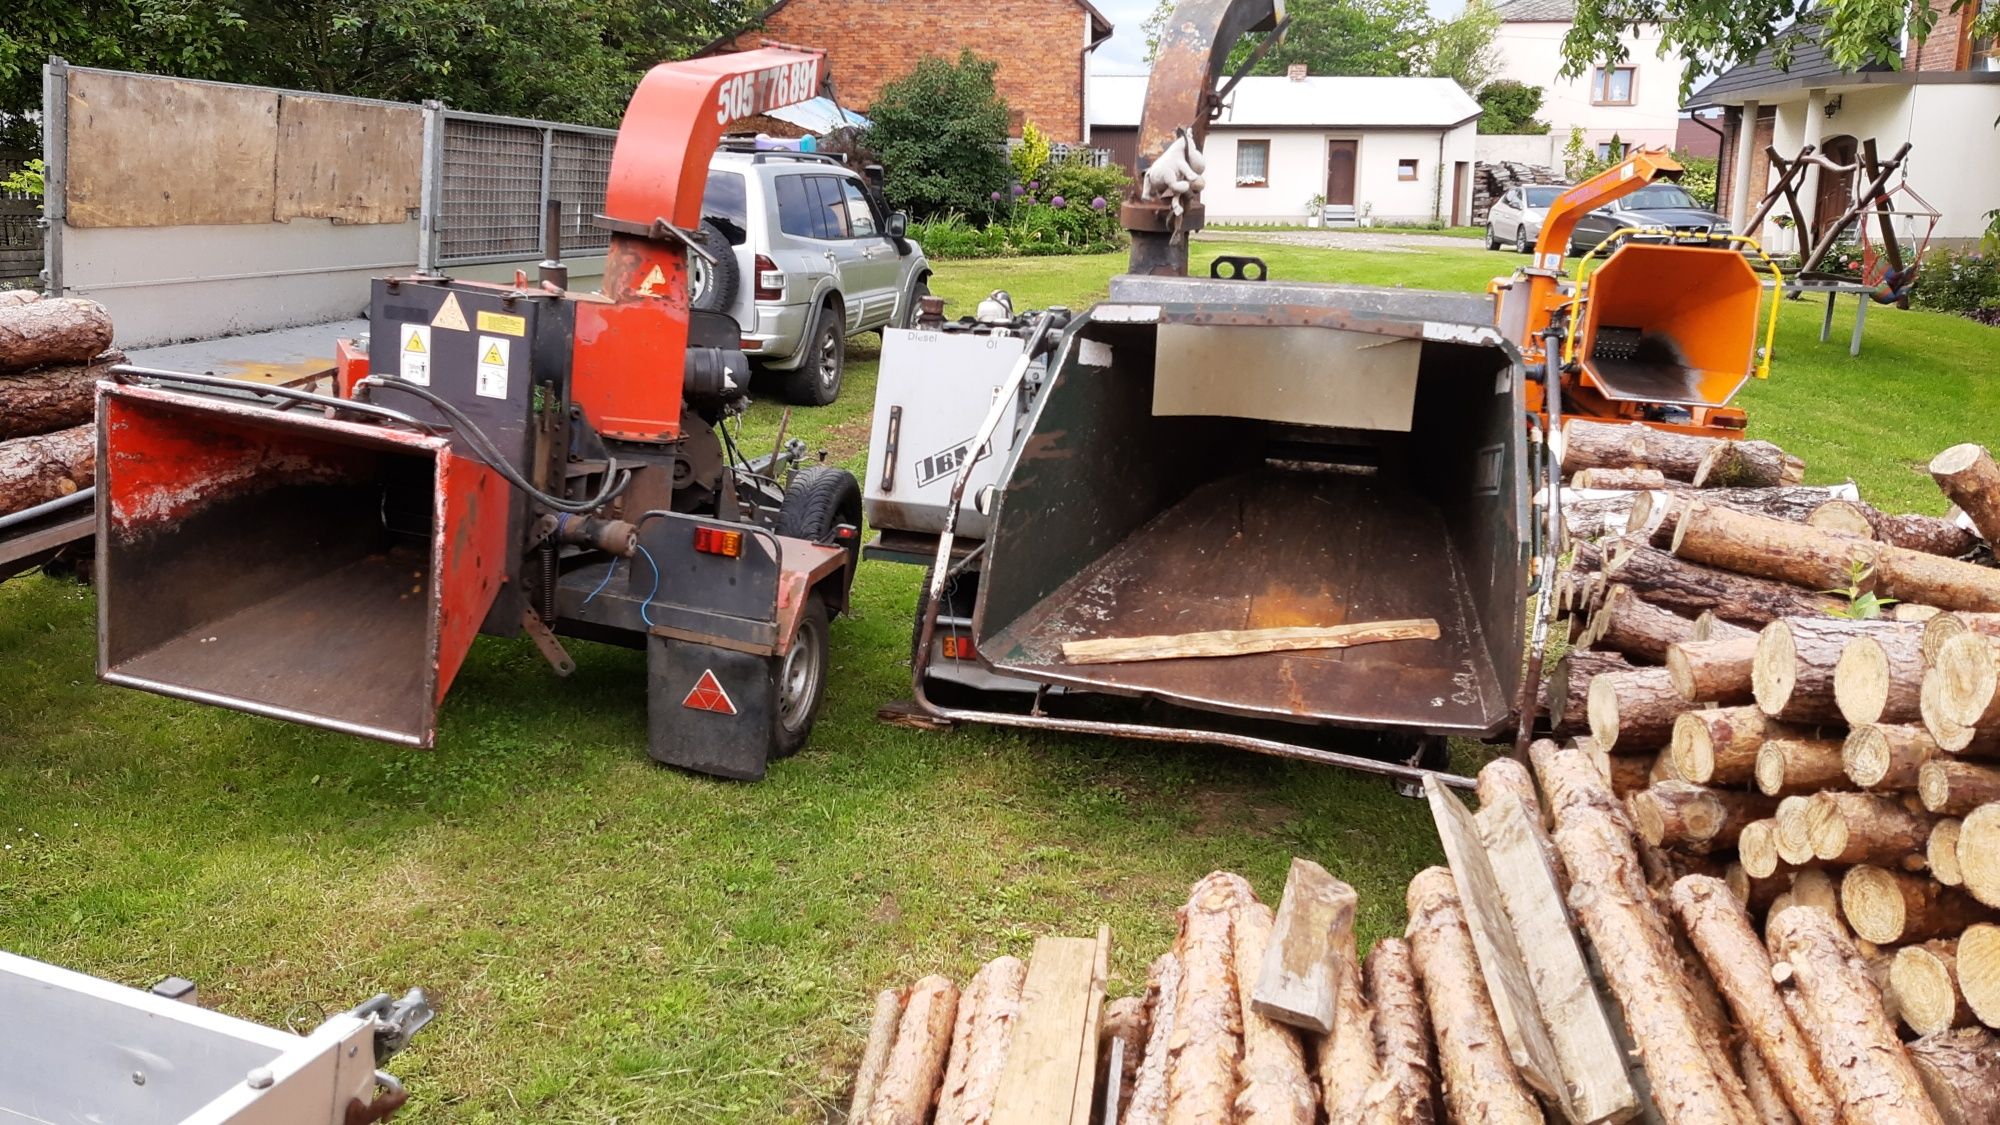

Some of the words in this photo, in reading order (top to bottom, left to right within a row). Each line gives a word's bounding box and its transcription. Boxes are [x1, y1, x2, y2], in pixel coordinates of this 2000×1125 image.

[718, 72, 755, 125] 505
[791, 59, 818, 102] 891
[907, 332, 938, 343] Diesel
